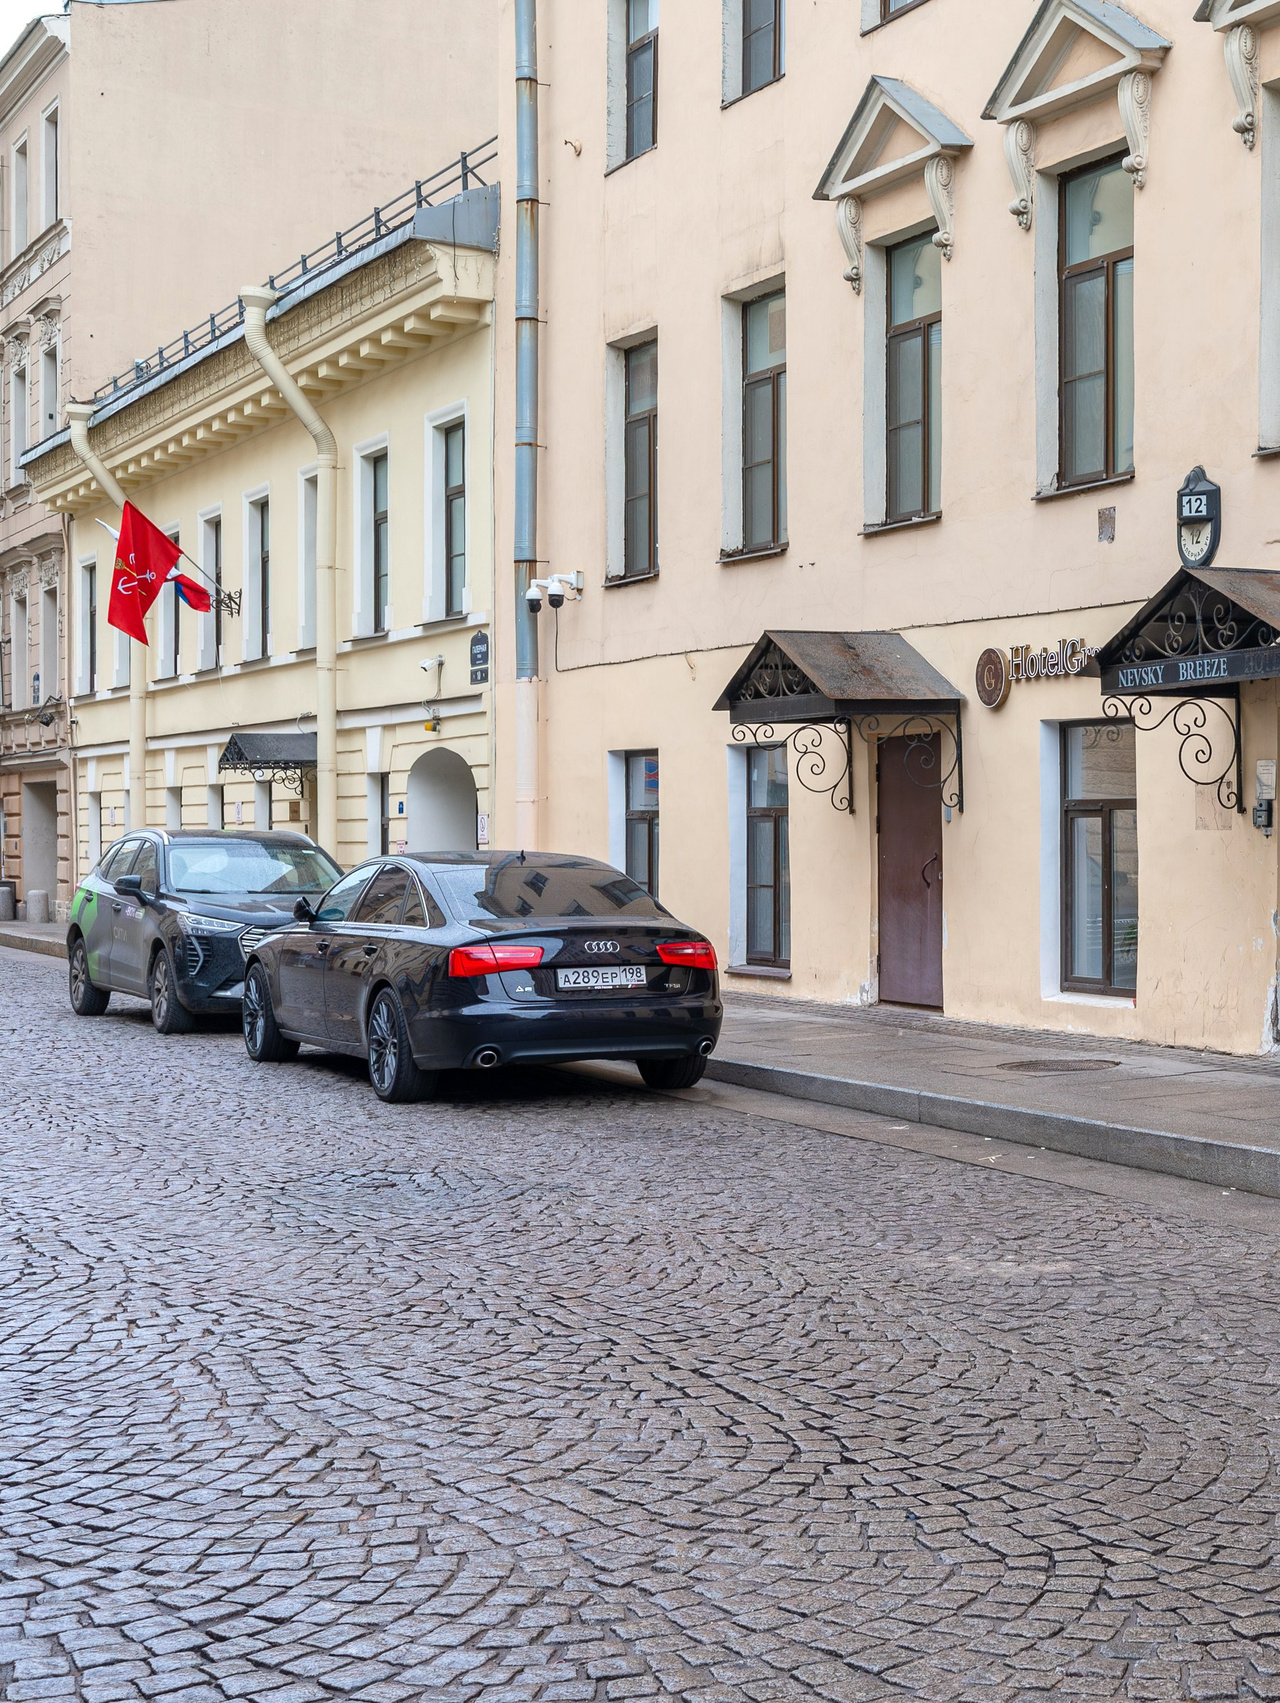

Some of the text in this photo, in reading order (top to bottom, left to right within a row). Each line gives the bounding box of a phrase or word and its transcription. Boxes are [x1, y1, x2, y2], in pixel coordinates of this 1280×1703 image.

[1185, 497, 1203, 514] 12
[1190, 529, 1201, 545] 12
[1118, 665, 1164, 688] NEVSKY
[1179, 658, 1228, 681] BREEZE
